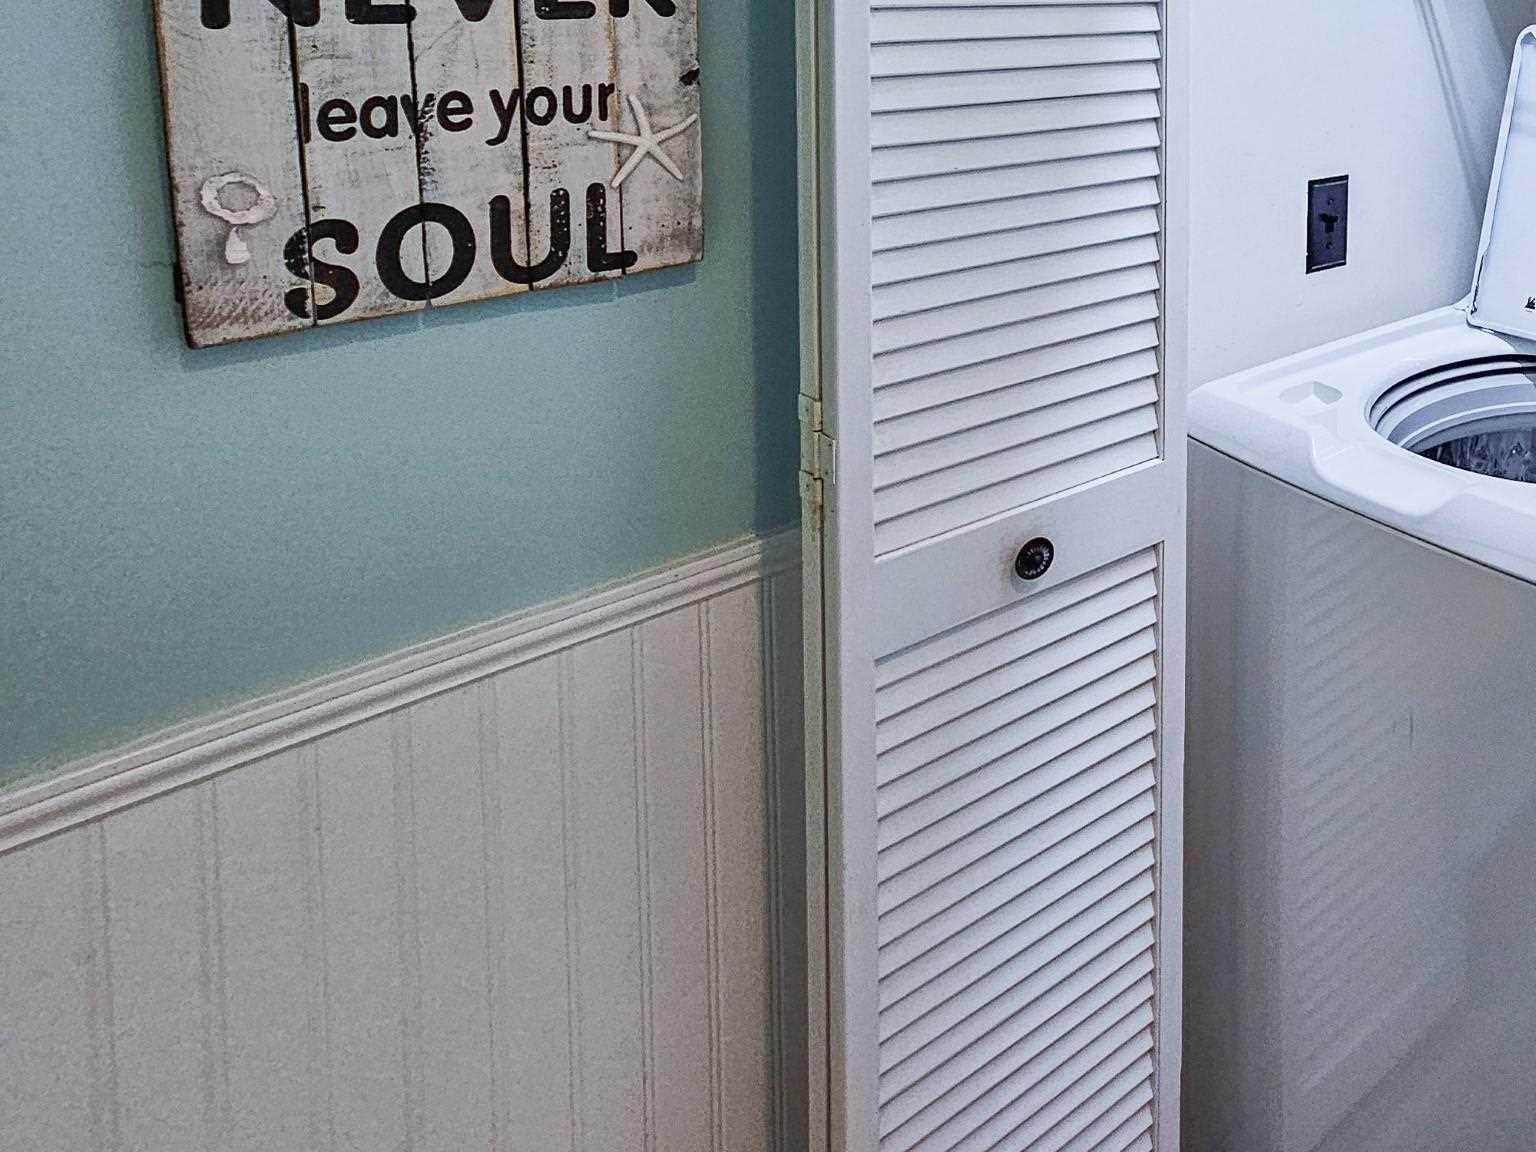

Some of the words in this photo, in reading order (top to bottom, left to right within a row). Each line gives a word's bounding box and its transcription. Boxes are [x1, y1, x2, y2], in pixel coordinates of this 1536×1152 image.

[299, 81, 474, 145] leave
[486, 80, 617, 147] your
[283, 181, 638, 320] SOUL
